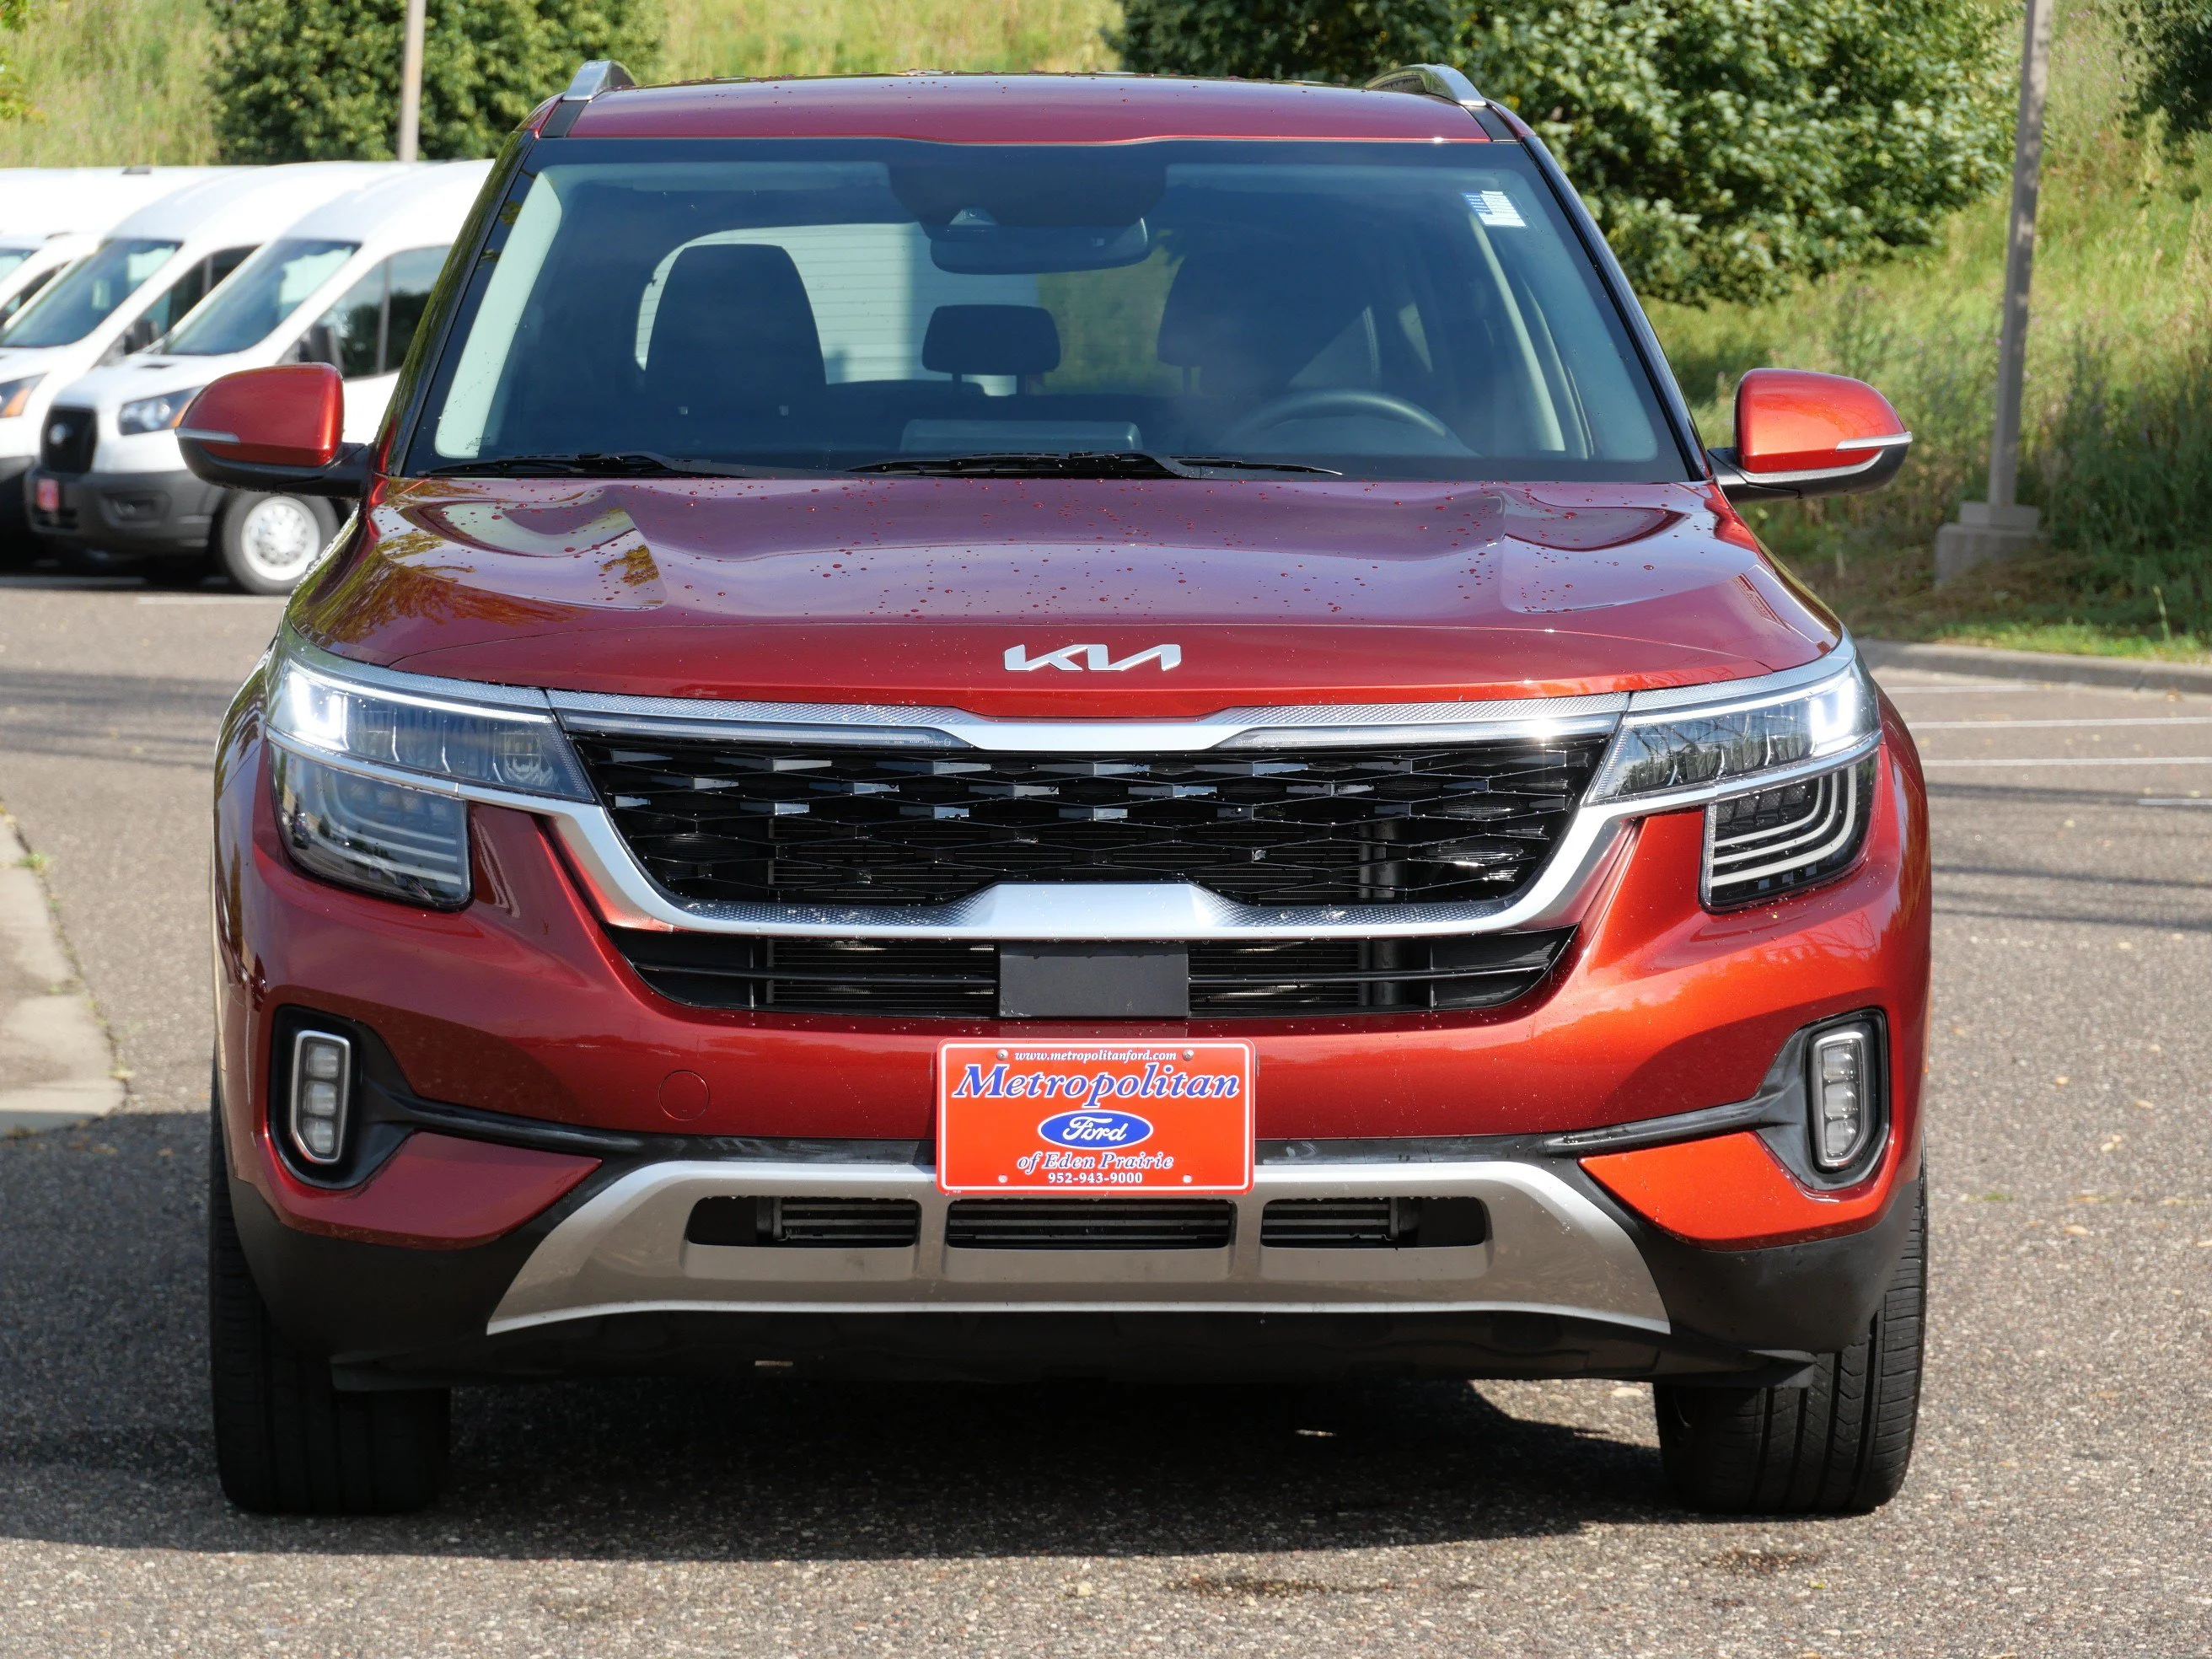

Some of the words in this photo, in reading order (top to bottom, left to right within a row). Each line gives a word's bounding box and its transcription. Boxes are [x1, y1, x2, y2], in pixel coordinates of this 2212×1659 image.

[1014, 1050, 1177, 1064] www.metropolitanford.com
[953, 1063, 1240, 1109] Metropolitan
[1062, 1116, 1129, 1141] Ford
[1017, 1151, 1043, 1175] of
[1041, 1152, 1096, 1169] Eden
[1098, 1151, 1174, 1169] Prairie
[1048, 1173, 1143, 1184] 952-943-9000
